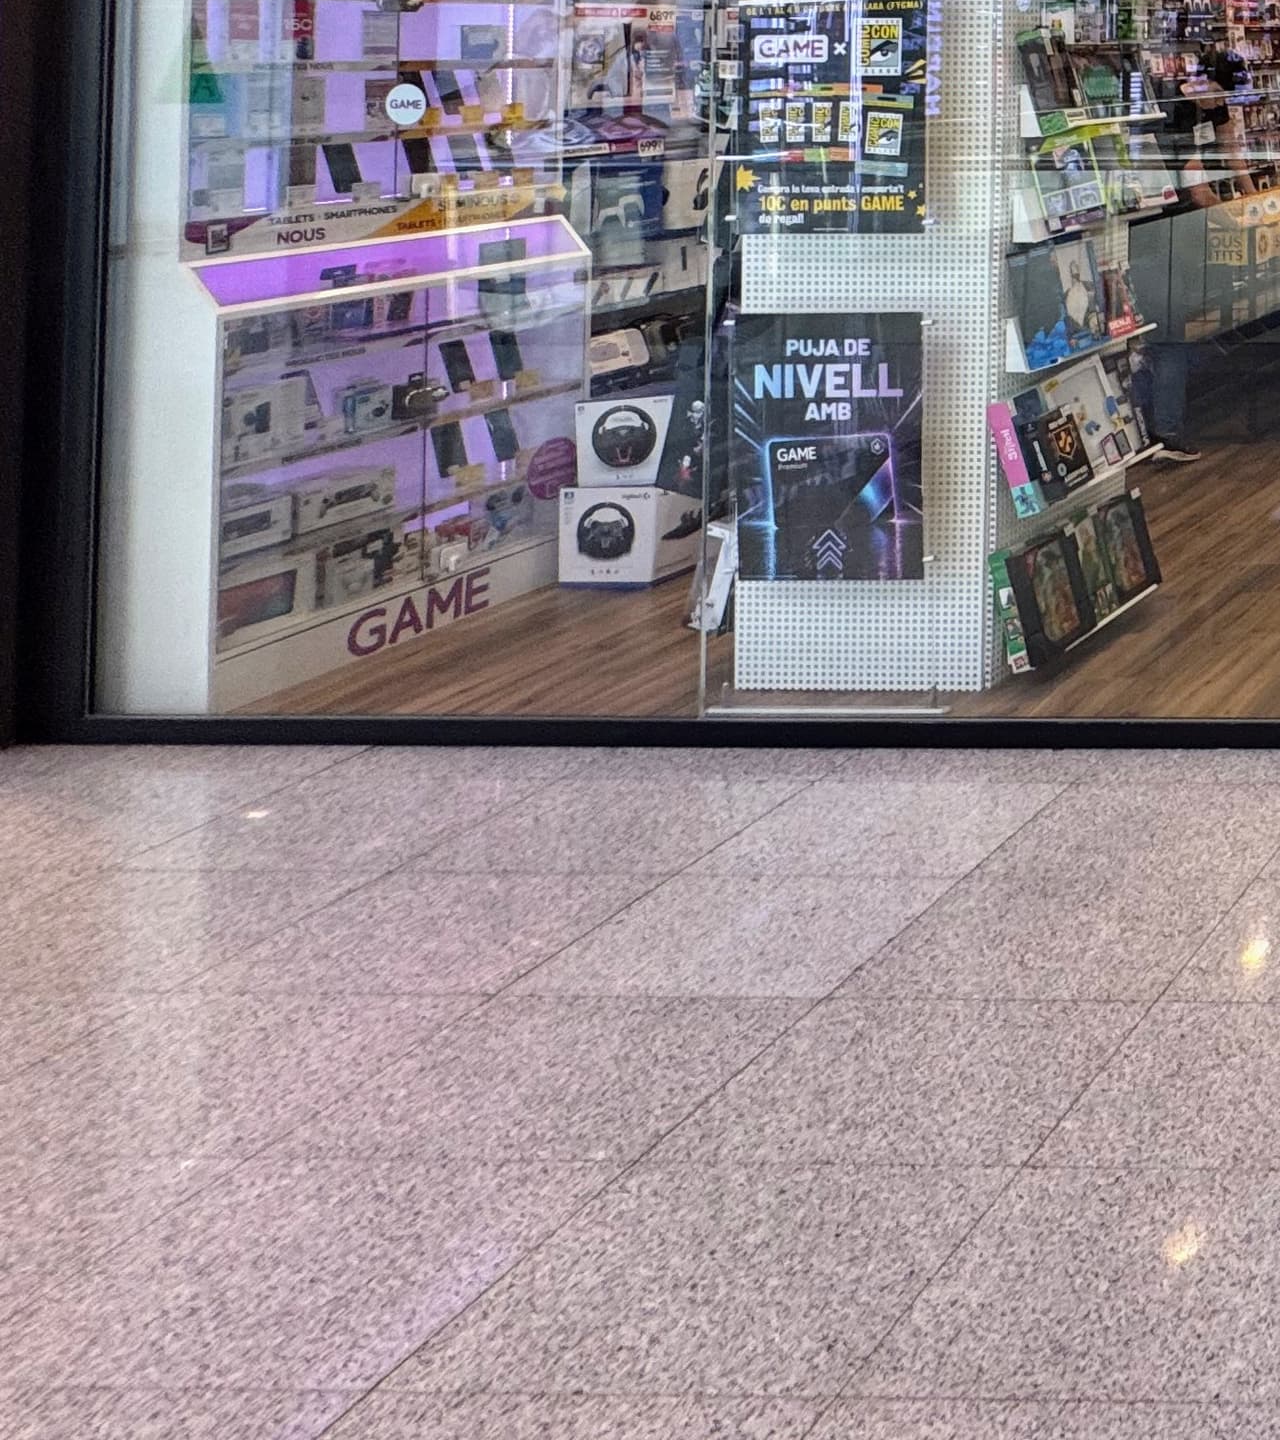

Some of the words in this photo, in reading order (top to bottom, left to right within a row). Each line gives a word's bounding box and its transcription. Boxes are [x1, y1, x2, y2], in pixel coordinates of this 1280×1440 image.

[871, 25, 899, 40] CON
[759, 39, 824, 58] GAME
[389, 98, 423, 111] GAME
[790, 198, 810, 211] en
[812, 196, 857, 213] punts
[860, 195, 905, 211] GAME
[269, 212, 315, 227] TABLETS
[323, 204, 398, 222] SMARTPHONES
[276, 228, 327, 245] NOUS
[1210, 235, 1243, 250] OUS
[1214, 249, 1243, 261] TITS
[785, 338, 840, 357] PUJA
[843, 338, 872, 356] DE
[753, 362, 904, 399] NIVELL
[804, 402, 852, 421] AMB
[776, 446, 817, 462] GAME
[347, 566, 491, 658] GAME
